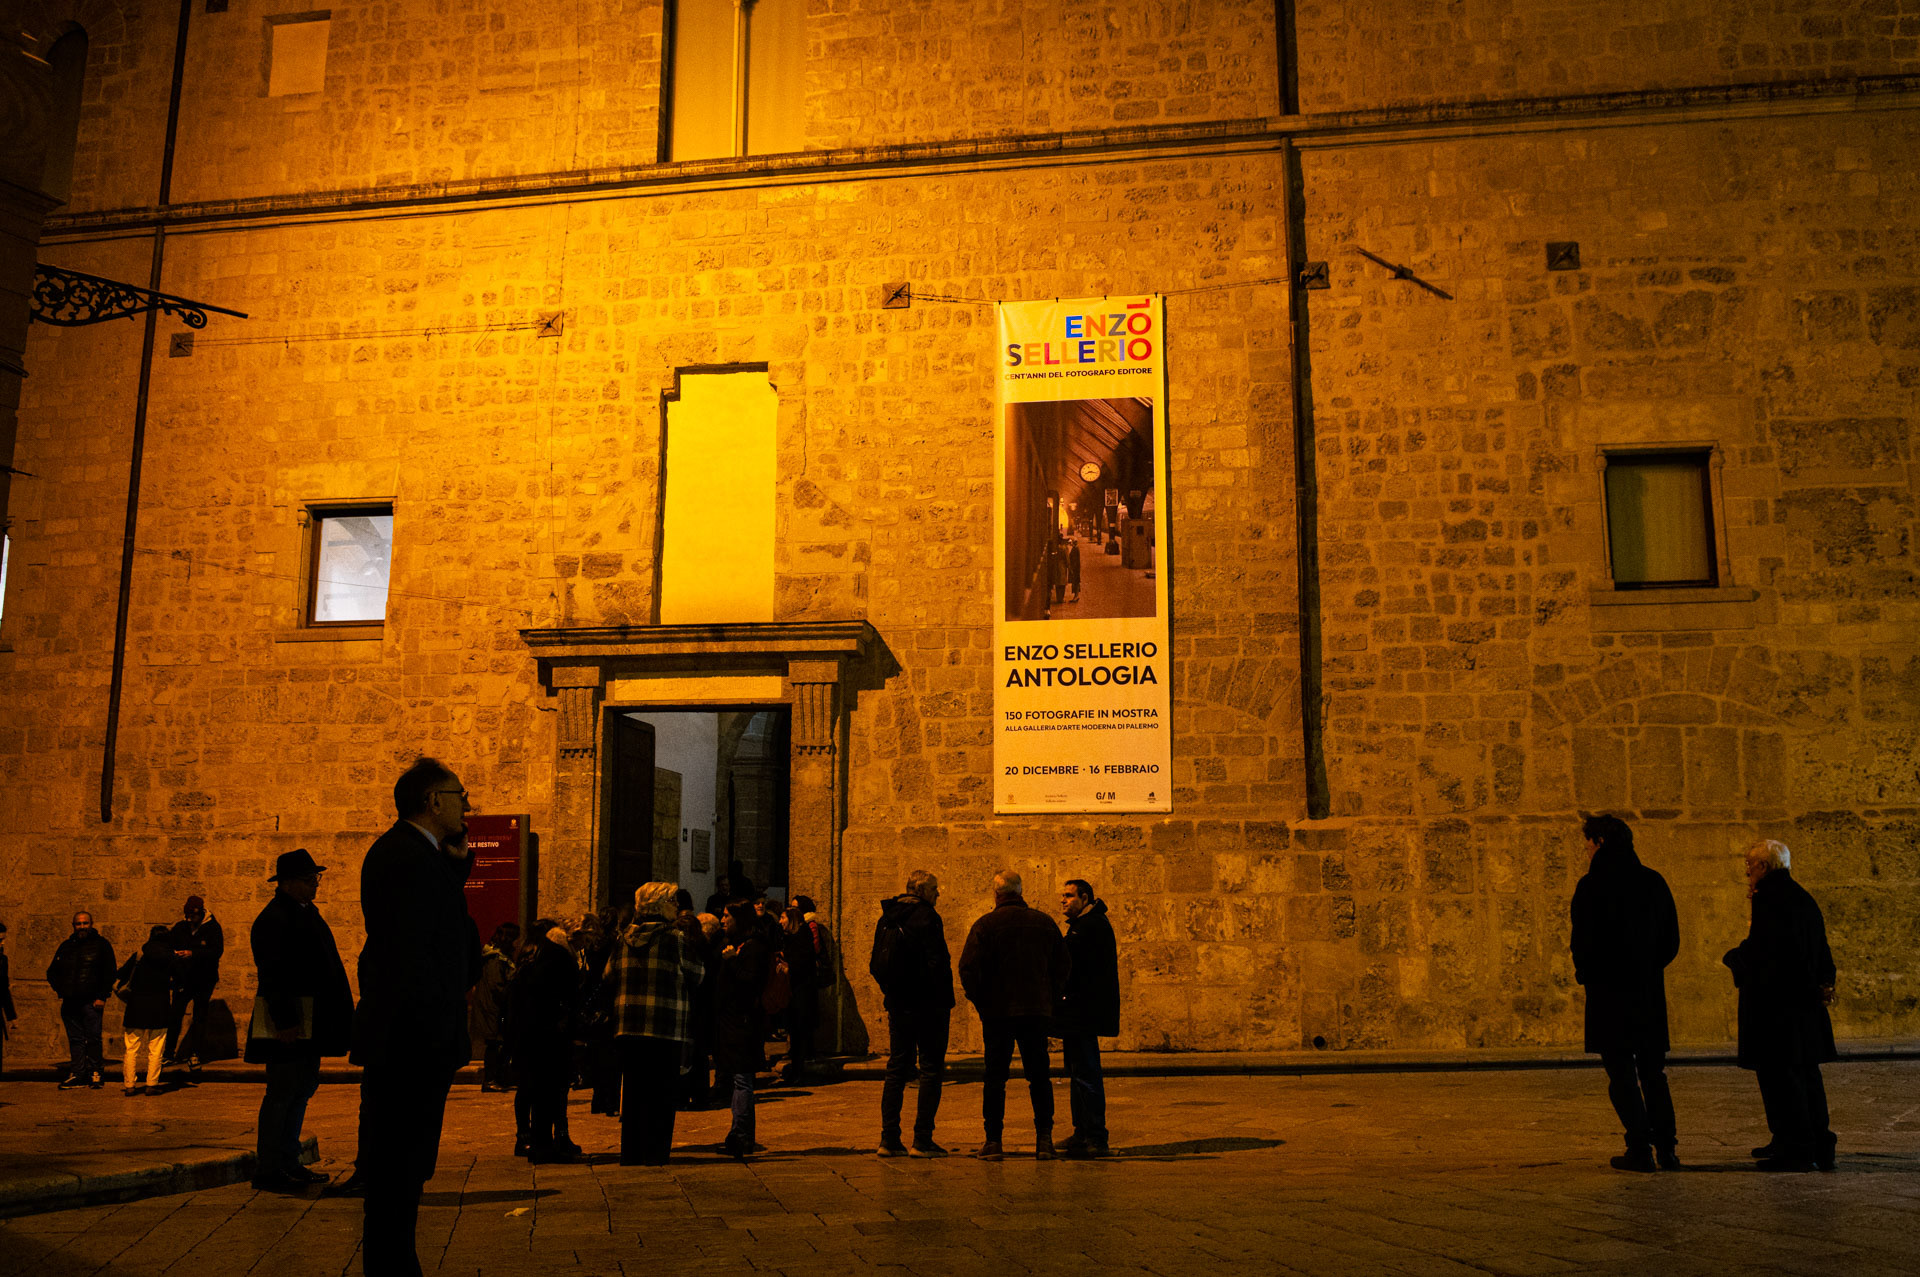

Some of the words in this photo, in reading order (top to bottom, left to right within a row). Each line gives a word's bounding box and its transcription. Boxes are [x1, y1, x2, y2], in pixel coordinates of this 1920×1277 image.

[1065, 313, 1152, 338] ENZO
[1005, 338, 1152, 367] SELLERIO
[1004, 372, 1047, 380] CENT'ANNI
[1066, 369, 1115, 378] FOTOGRAFO
[1117, 367, 1152, 376] EDITORE
[1004, 644, 1059, 661] ENZO
[1063, 642, 1158, 660] SELLERIO
[1006, 665, 1158, 688] ANTOLOGIA
[1005, 711, 1022, 720] 150
[1025, 709, 1094, 720] FOTOGRAFIE
[1097, 709, 1109, 718] IN
[1112, 708, 1158, 718] MOSTRA
[1023, 724, 1056, 732] GALLERIA
[1126, 722, 1159, 730] PALERMO
[1005, 766, 1018, 775] 20
[1023, 765, 1079, 775] DICEMBRE
[1089, 765, 1100, 774] 16
[1104, 764, 1159, 774] FEBBRAIO
